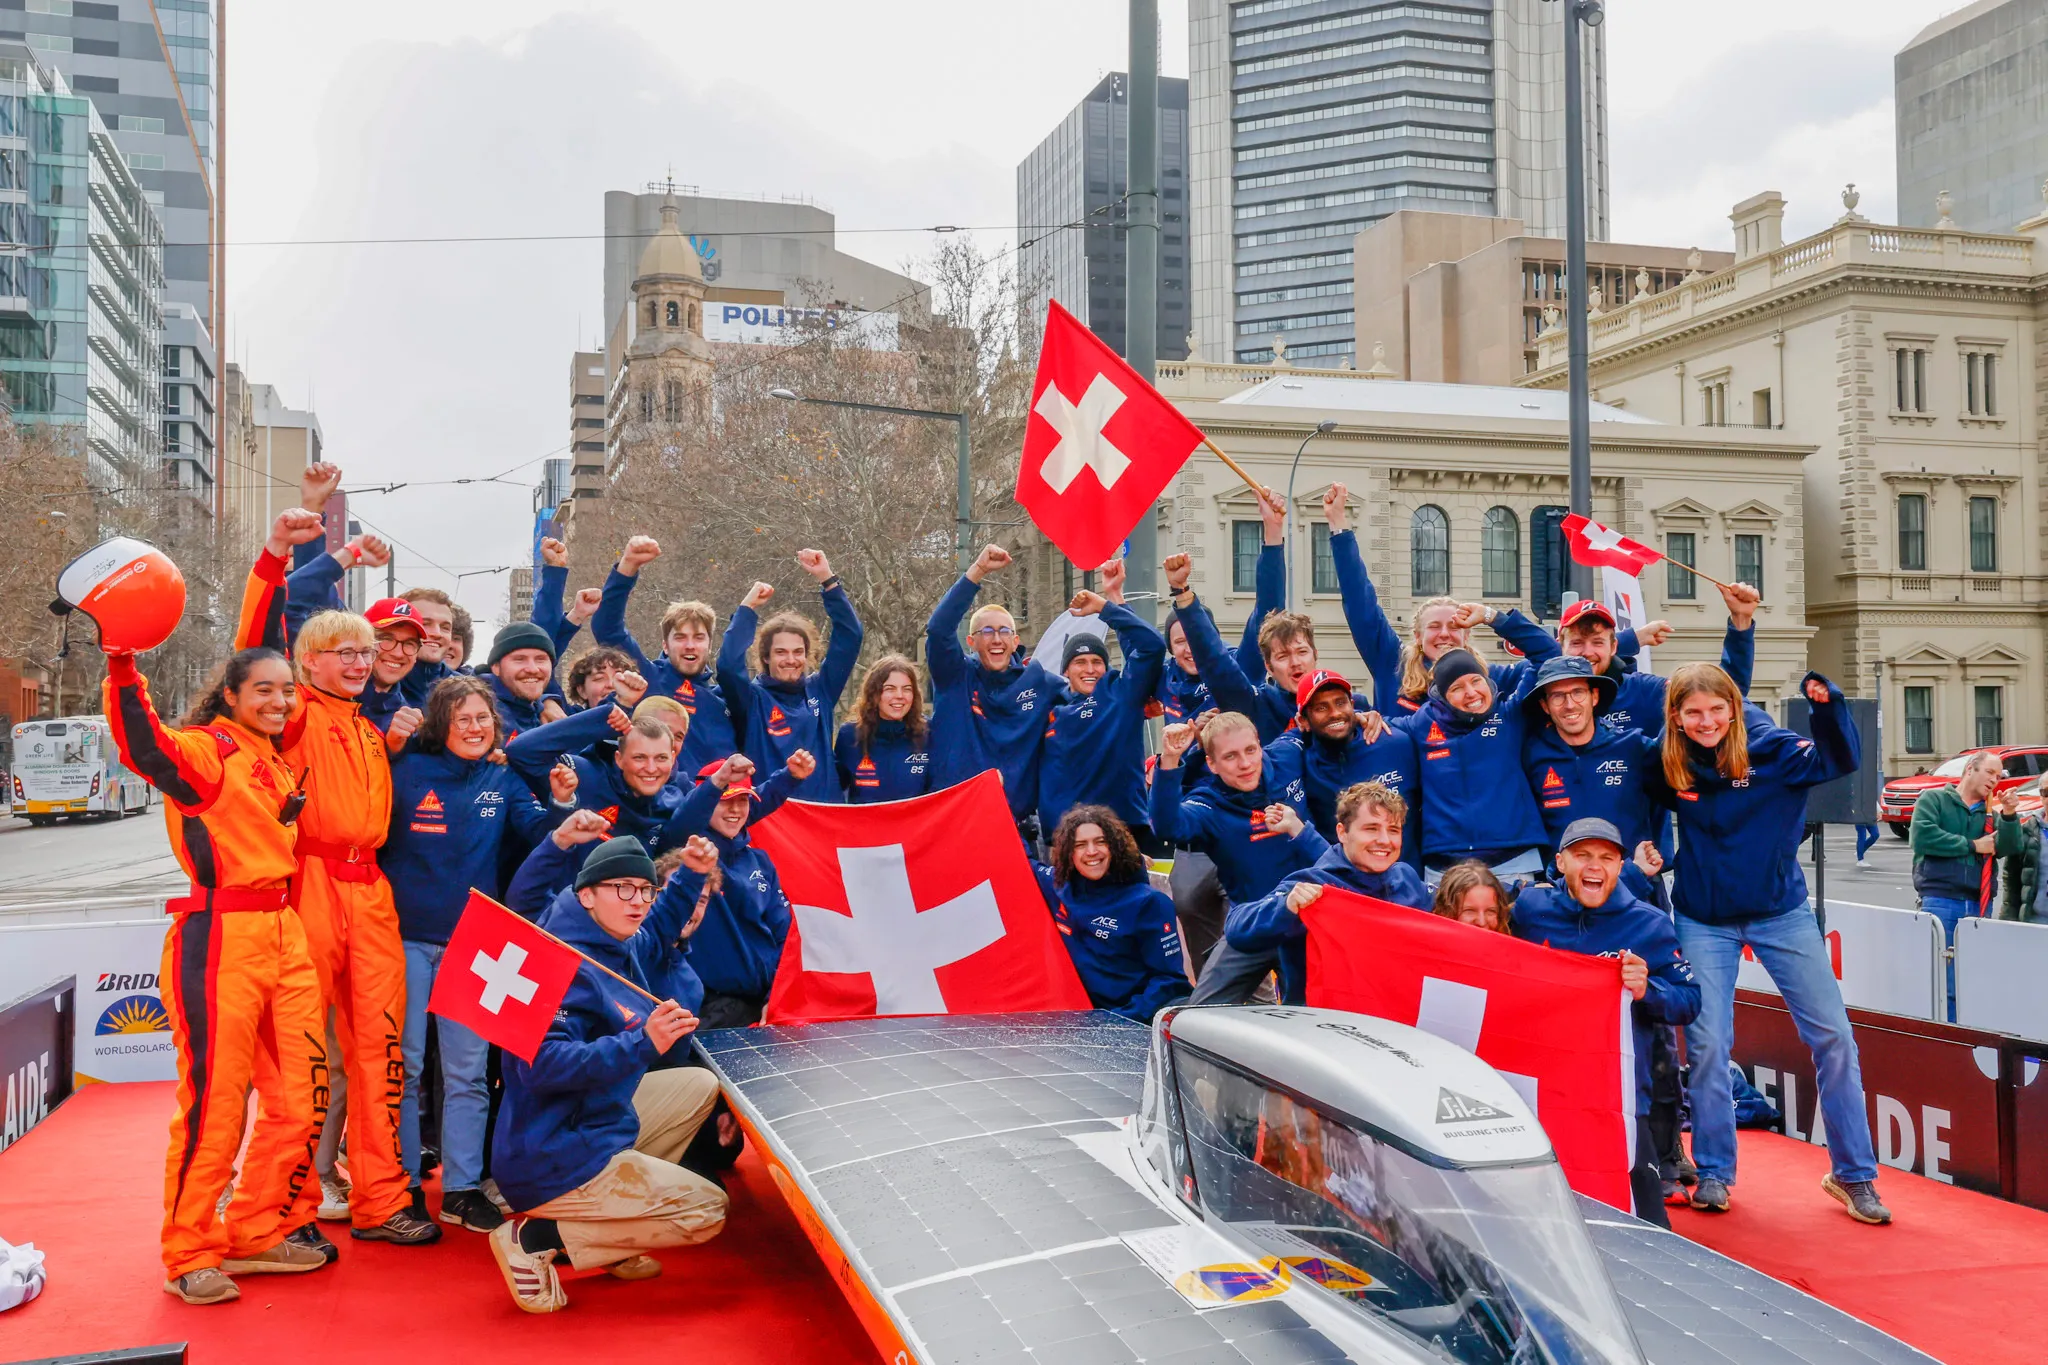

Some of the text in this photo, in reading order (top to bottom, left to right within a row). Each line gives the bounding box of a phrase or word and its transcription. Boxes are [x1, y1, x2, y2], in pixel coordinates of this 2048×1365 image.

[1016, 688, 1038, 701] ACE
[1021, 701, 1034, 711] 85
[1080, 709, 1093, 719] 85
[1603, 710, 1631, 722] ACE
[1480, 727, 1498, 737] 85
[904, 753, 930, 761] ACE
[910, 765, 925, 774] 85
[1596, 760, 1628, 771] ACE
[1374, 770, 1403, 785] ACE
[1604, 775, 1623, 786] 85
[1731, 779, 1750, 788] 85
[474, 790, 504, 802] ACE
[1293, 788, 1305, 803] 85
[480, 807, 497, 818] 85
[1091, 915, 1119, 929] ACE
[1095, 929, 1110, 940] 85
[1441, 1096, 1497, 1120] Sika
[1443, 1125, 1526, 1139] BUILDING TRUST
